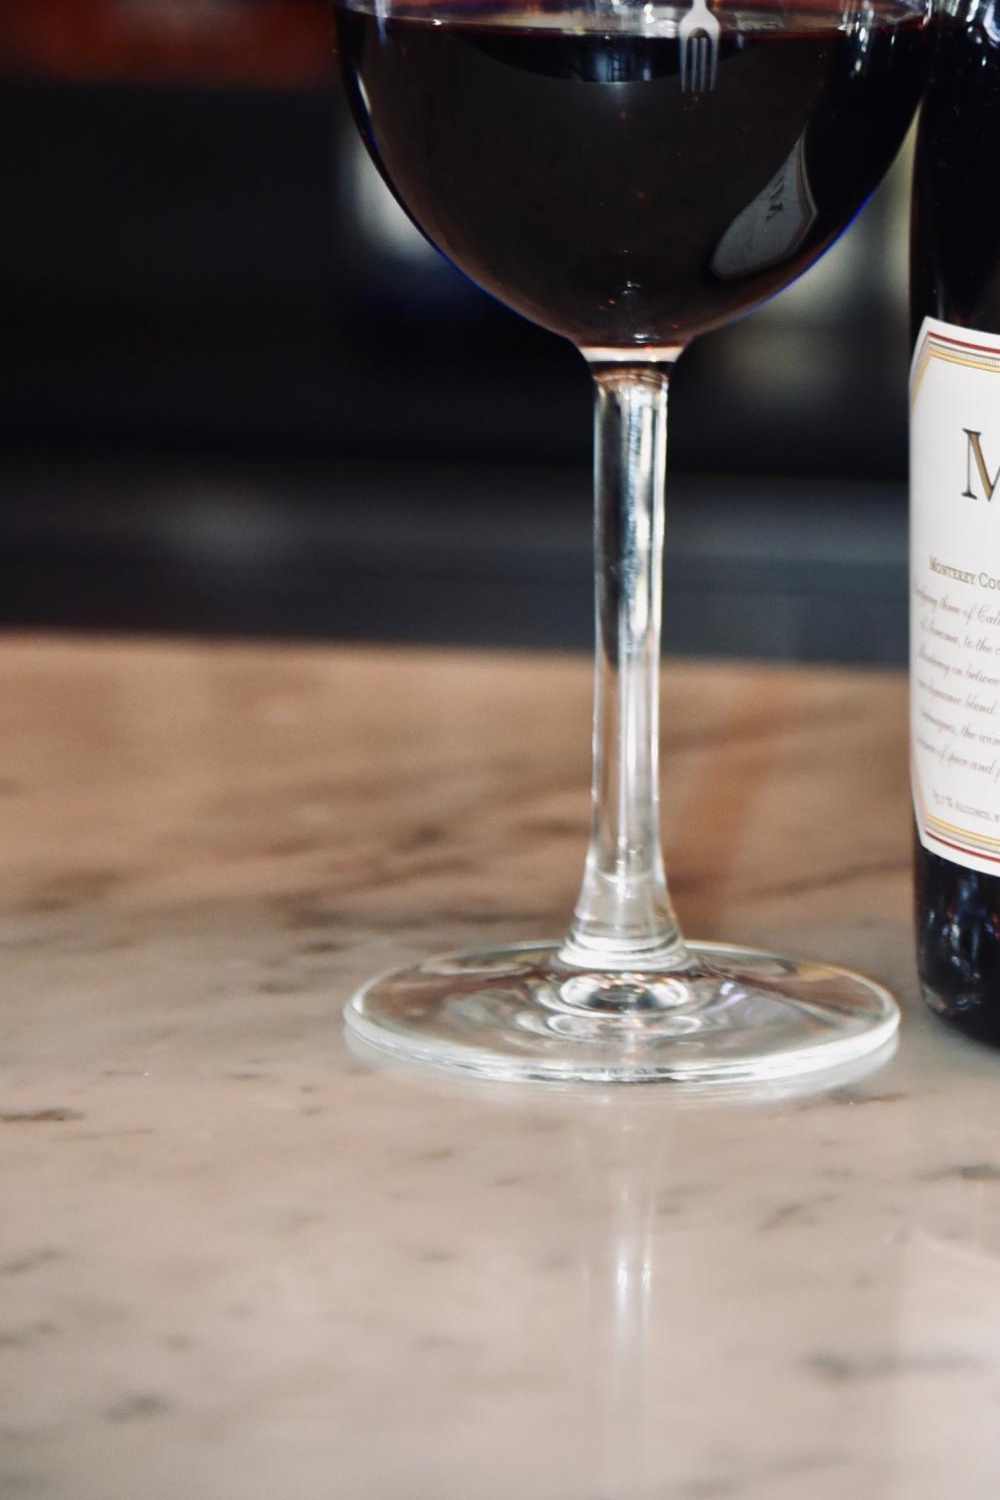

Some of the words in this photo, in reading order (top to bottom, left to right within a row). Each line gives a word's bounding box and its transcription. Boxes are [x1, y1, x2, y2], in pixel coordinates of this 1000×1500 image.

[929, 555, 977, 585] MONTEREY
[975, 636, 994, 653] the
[970, 759, 998, 775] and
